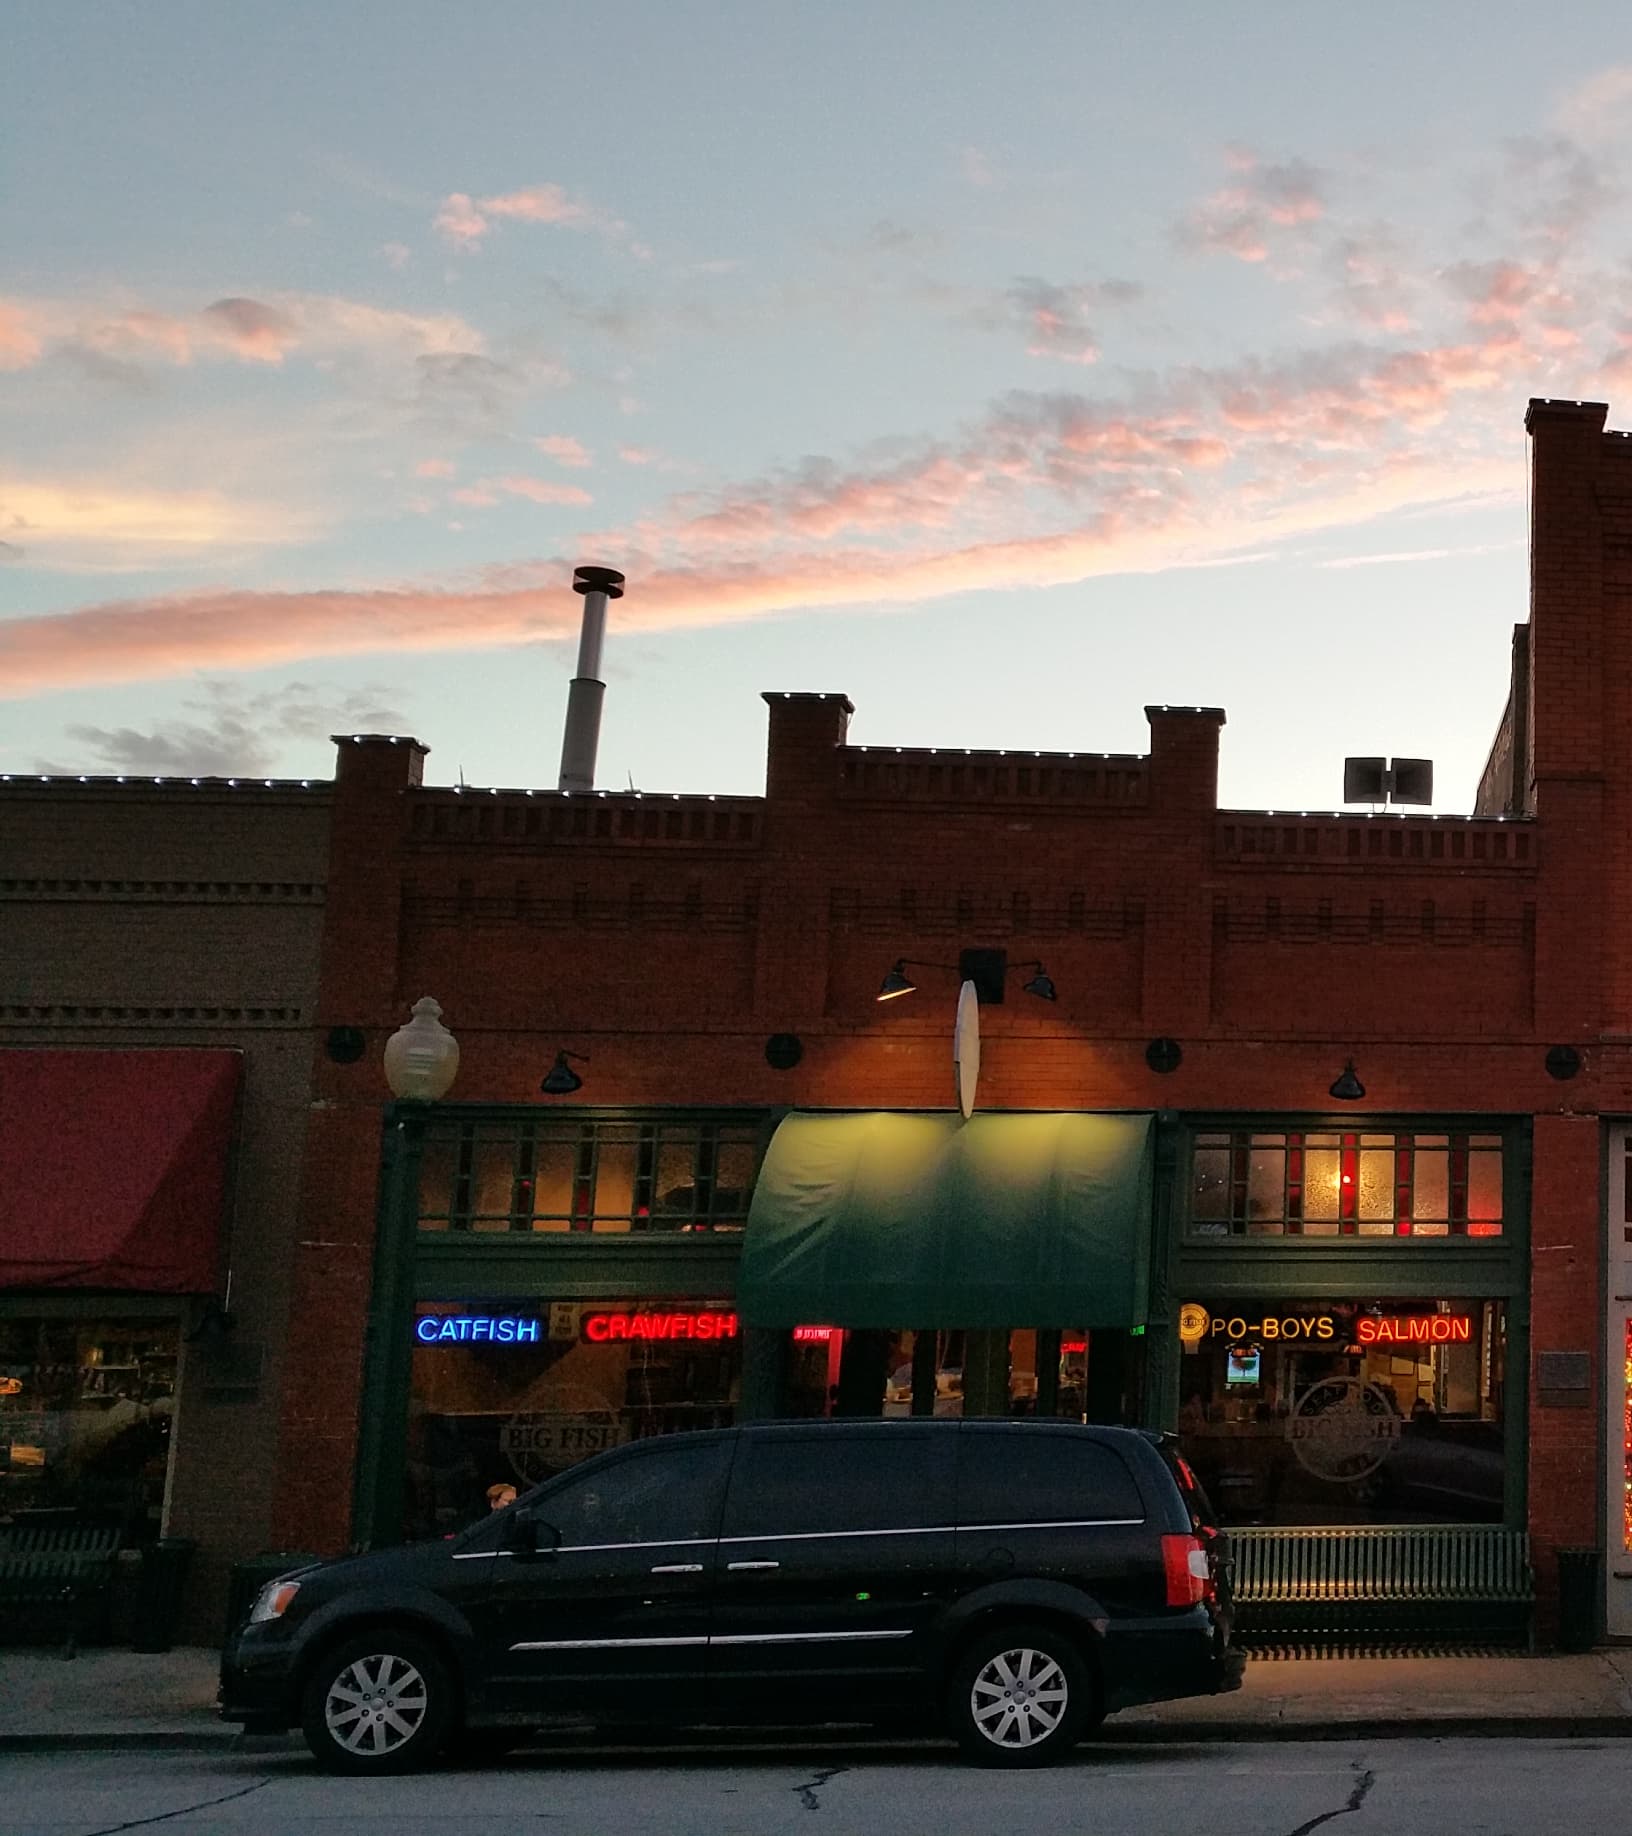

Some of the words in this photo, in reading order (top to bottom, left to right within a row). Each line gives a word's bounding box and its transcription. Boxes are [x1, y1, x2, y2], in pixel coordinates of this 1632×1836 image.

[416, 1318, 540, 1342] CATFISH
[585, 1313, 738, 1341] CRAWFISH
[1211, 1316, 1334, 1339] PO-BOYS
[1358, 1317, 1471, 1342] SALMON
[509, 1428, 552, 1448] BIG
[560, 1427, 621, 1448] FISH
